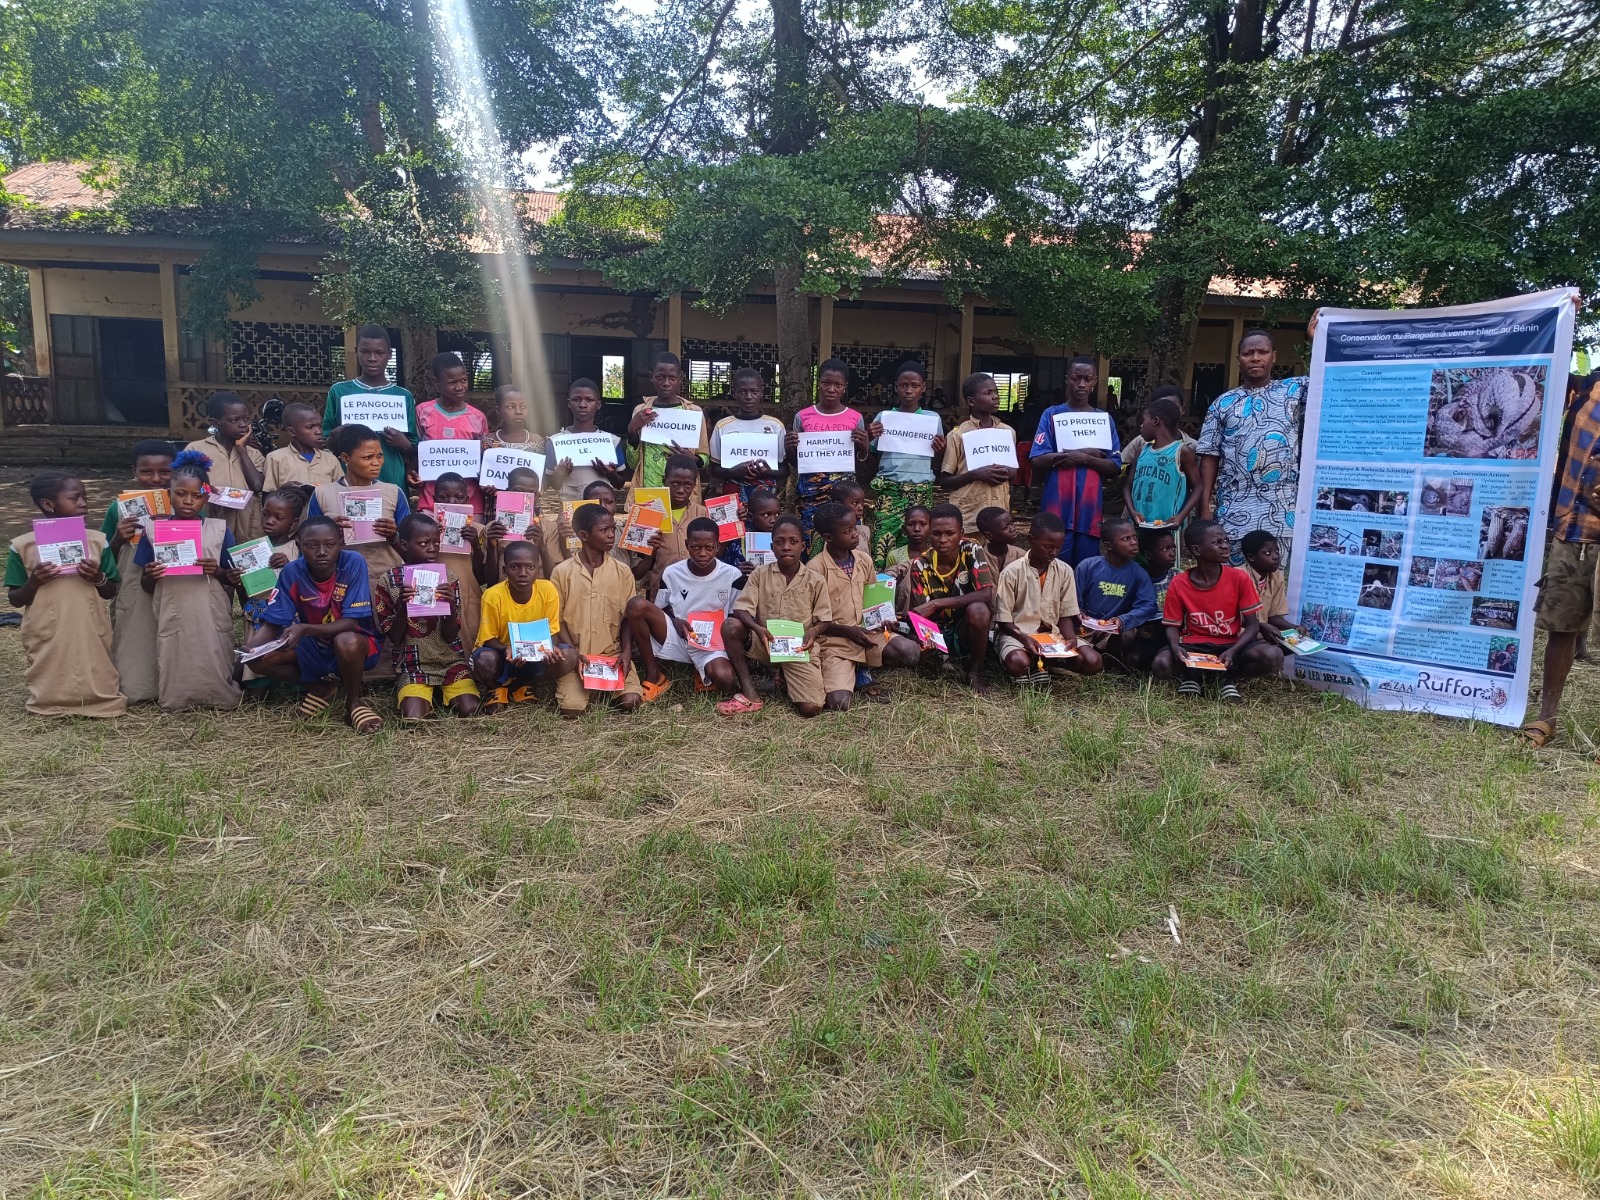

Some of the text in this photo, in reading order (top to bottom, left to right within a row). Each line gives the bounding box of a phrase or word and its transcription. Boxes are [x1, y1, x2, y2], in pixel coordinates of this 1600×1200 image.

[1340, 333, 1391, 342] Conservation
[1393, 332, 1403, 340] du
[1404, 331, 1438, 342] Pangolin
[1448, 330, 1473, 338] ventre
[1476, 327, 1499, 336] blanc
[1500, 326, 1512, 334] au
[1512, 323, 1539, 334] Bénin
[646, 422, 697, 431] PANGOLINS
[1056, 419, 1068, 427] TO
[806, 438, 844, 446] HARMFUL,
[430, 447, 469, 455] DANGER,
[730, 448, 769, 457] ARE NOT
[972, 445, 1011, 455] ACT NOW
[422, 459, 445, 467] C'EST
[496, 455, 531, 467] EST EN
[486, 469, 509, 480] DAN
[1098, 581, 1126, 594] SONIC
[1208, 621, 1233, 636] BOY
